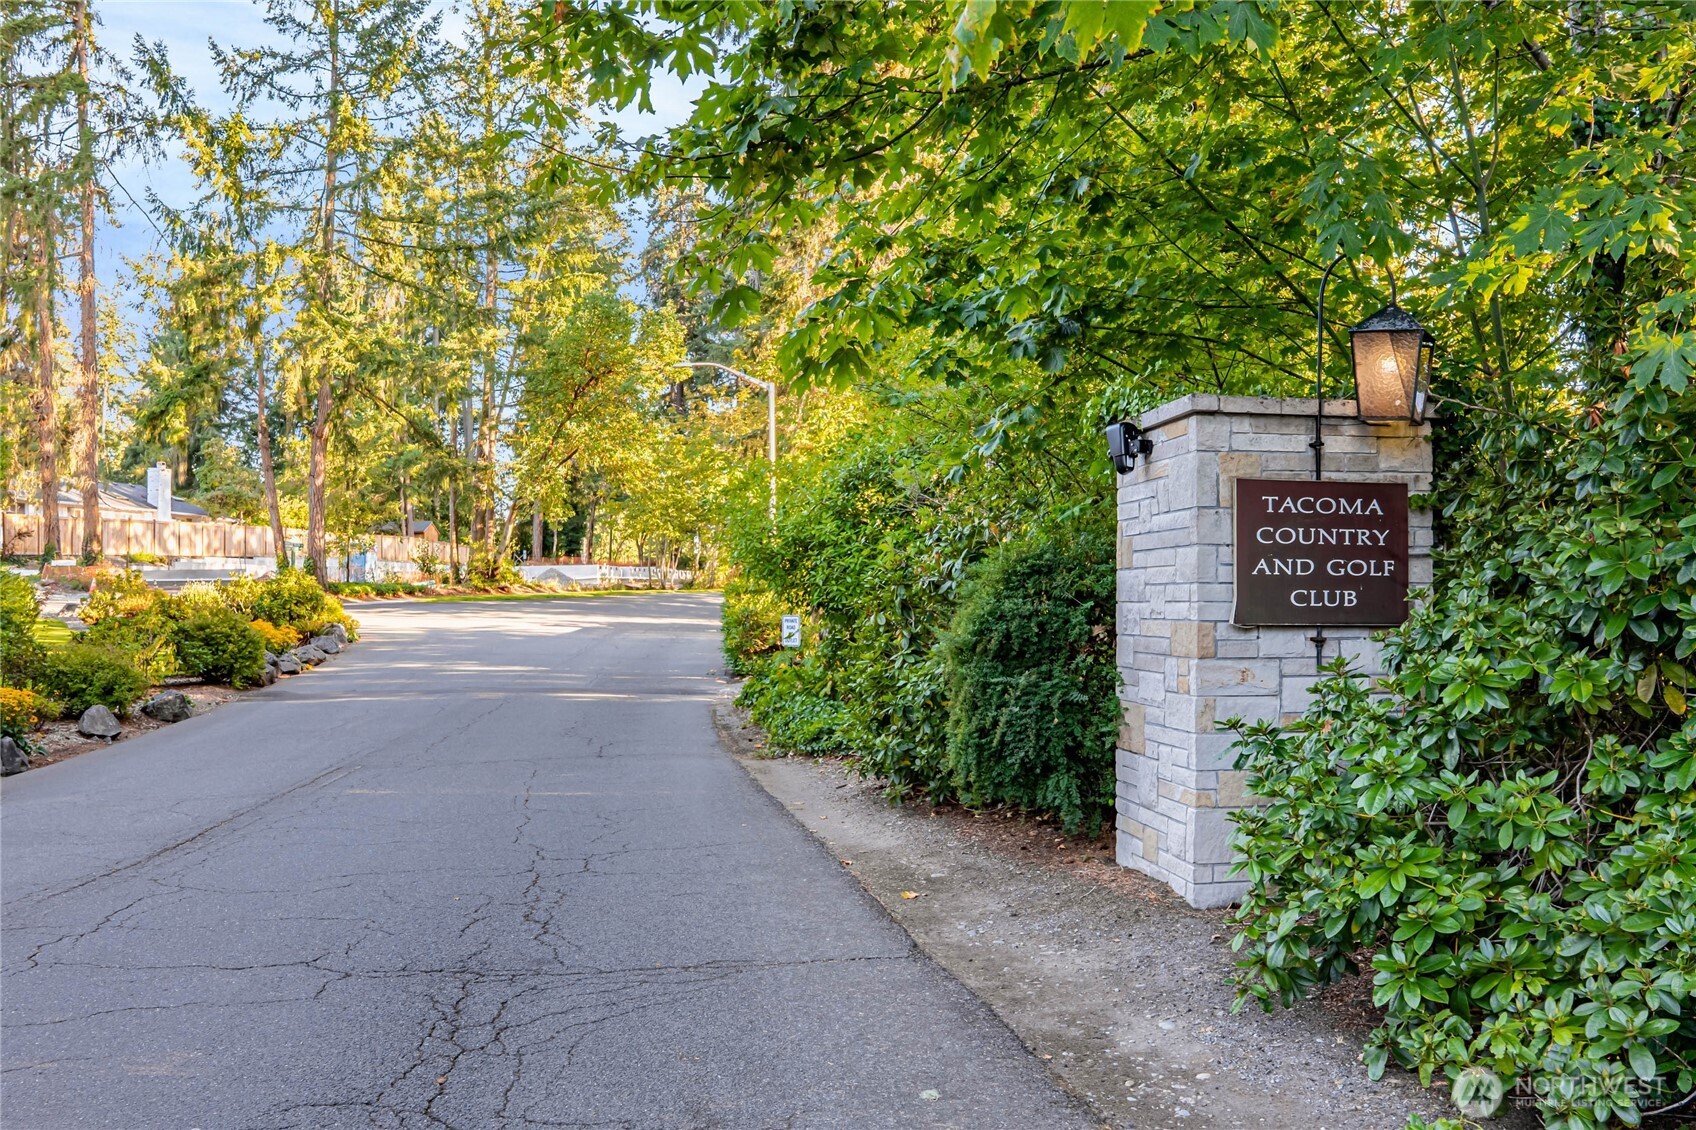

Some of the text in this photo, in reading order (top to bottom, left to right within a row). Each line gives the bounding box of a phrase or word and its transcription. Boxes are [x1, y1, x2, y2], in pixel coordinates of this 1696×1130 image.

[1262, 496, 1384, 515] TACOMA
[1256, 527, 1390, 546] COUNTRY
[1252, 558, 1395, 577] AND GOLF
[1290, 590, 1358, 607] CLUB
